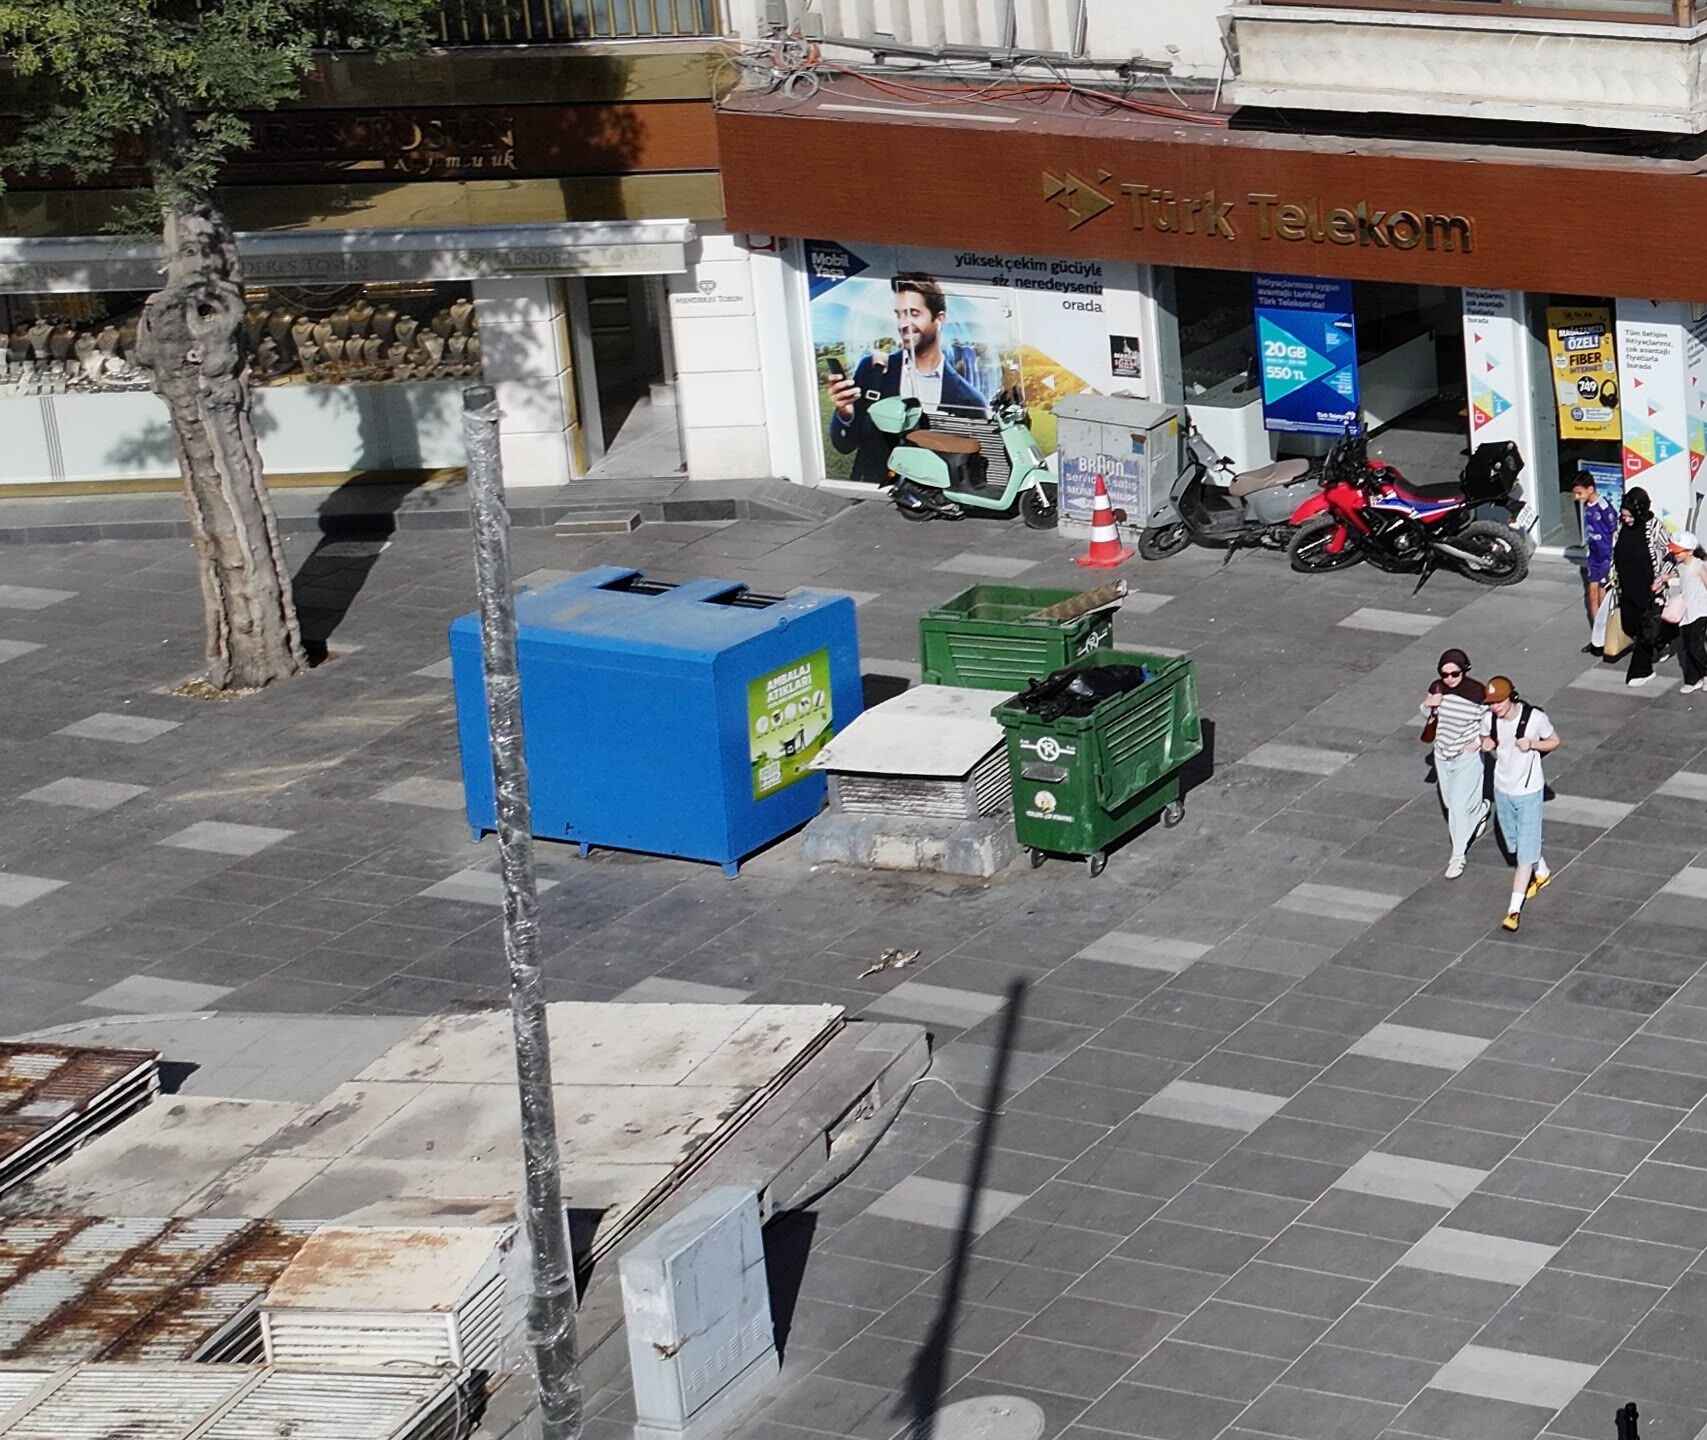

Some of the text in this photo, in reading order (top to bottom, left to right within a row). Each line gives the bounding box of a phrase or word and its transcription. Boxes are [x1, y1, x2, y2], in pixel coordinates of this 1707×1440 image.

[1120, 181, 1477, 254] Türk Telekom
[811, 252, 850, 268] Mobil
[954, 252, 1103, 278] yüksek çekim gücüyle
[812, 264, 847, 282] Yaşa
[992, 274, 1104, 296] siz neredeyseniz
[1264, 340, 1307, 359] 20 GB
[1567, 334, 1599, 351] ÖZEL!
[1266, 366, 1308, 381] 550 TL
[1578, 381, 1597, 392] 749
[766, 663, 811, 692] AMBALAJ
[767, 674, 812, 704] ATIKLARI
